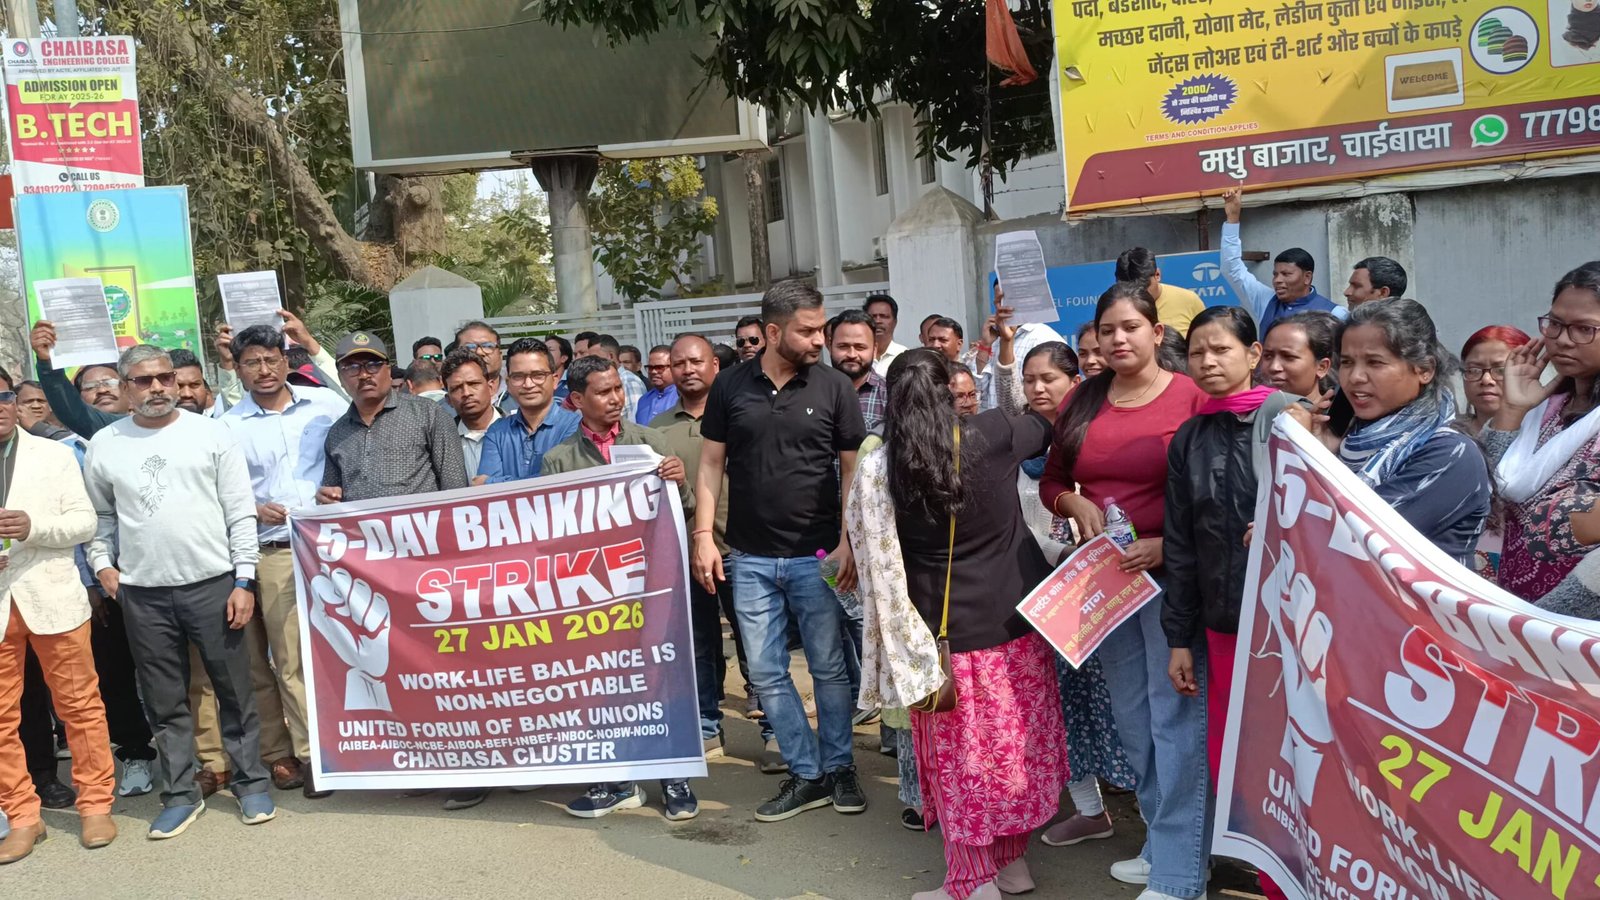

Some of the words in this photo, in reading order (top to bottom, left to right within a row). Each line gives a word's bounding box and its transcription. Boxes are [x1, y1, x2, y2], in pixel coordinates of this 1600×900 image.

[1097, 26, 1144, 48] मच्छर
[1147, 16, 1189, 41] दानी,
[1192, 12, 1234, 36] योगा
[1237, 8, 1270, 31] मेट,
[1274, 0, 1323, 26] लेडीज
[41, 40, 128, 56] CHAIBASA
[43, 58, 95, 66] ENGINEERING
[1147, 52, 1189, 78] जेंट्स
[1192, 46, 1241, 68] लोअर
[1244, 38, 1267, 64] एवं
[1270, 32, 1322, 60] टी-शर्ट
[1327, 29, 1359, 52] और
[1362, 22, 1400, 48] बच्चों
[1402, 20, 1420, 43] के
[1423, 14, 1462, 42] कपड़े
[24, 80, 87, 92] ADMISSION
[90, 80, 118, 91] OPEN
[1182, 83, 1215, 96] 2000/-
[1400, 72, 1448, 85] WELCOME
[71, 92, 104, 100] 2025-26
[16, 112, 132, 138] B.TECH
[1146, 134, 1169, 142] TERMS
[1188, 126, 1228, 136] CONDITION
[1228, 122, 1258, 132] APPLIES
[1199, 146, 1248, 180] मधु
[1250, 137, 1336, 168] बाजार,
[1341, 122, 1452, 158] चाईबासा
[90, 172, 100, 180] US
[1066, 296, 1100, 306] FOUN
[315, 510, 442, 562] 5-DAY
[452, 476, 662, 550] BANKING
[416, 538, 646, 622] STRIKE
[434, 628, 470, 653] 27
[482, 620, 554, 651] JAN
[564, 602, 644, 640] 2026
[1411, 581, 1600, 697] BAN
[398, 666, 524, 690] WORK-LIFE
[532, 650, 645, 680] BALANCE
[652, 642, 676, 663] IS
[435, 674, 648, 712] NON-NEGOTIABLE
[338, 720, 407, 739] UNITED
[413, 720, 480, 738] FORUM
[486, 717, 513, 734] OF
[520, 710, 582, 732] BANK
[588, 701, 664, 726] UNIONS
[338, 724, 669, 753] (AIBEA-AIBOC-NCBE-AIBOA-BEFI-INBEF-INBOC-NOBW-NOBO)
[392, 748, 508, 769] CHAIBASA
[513, 742, 616, 765] CLUSTER
[1268, 768, 1322, 858] UNIED
[1378, 734, 1452, 802] 27
[1458, 790, 1582, 900] JAN
